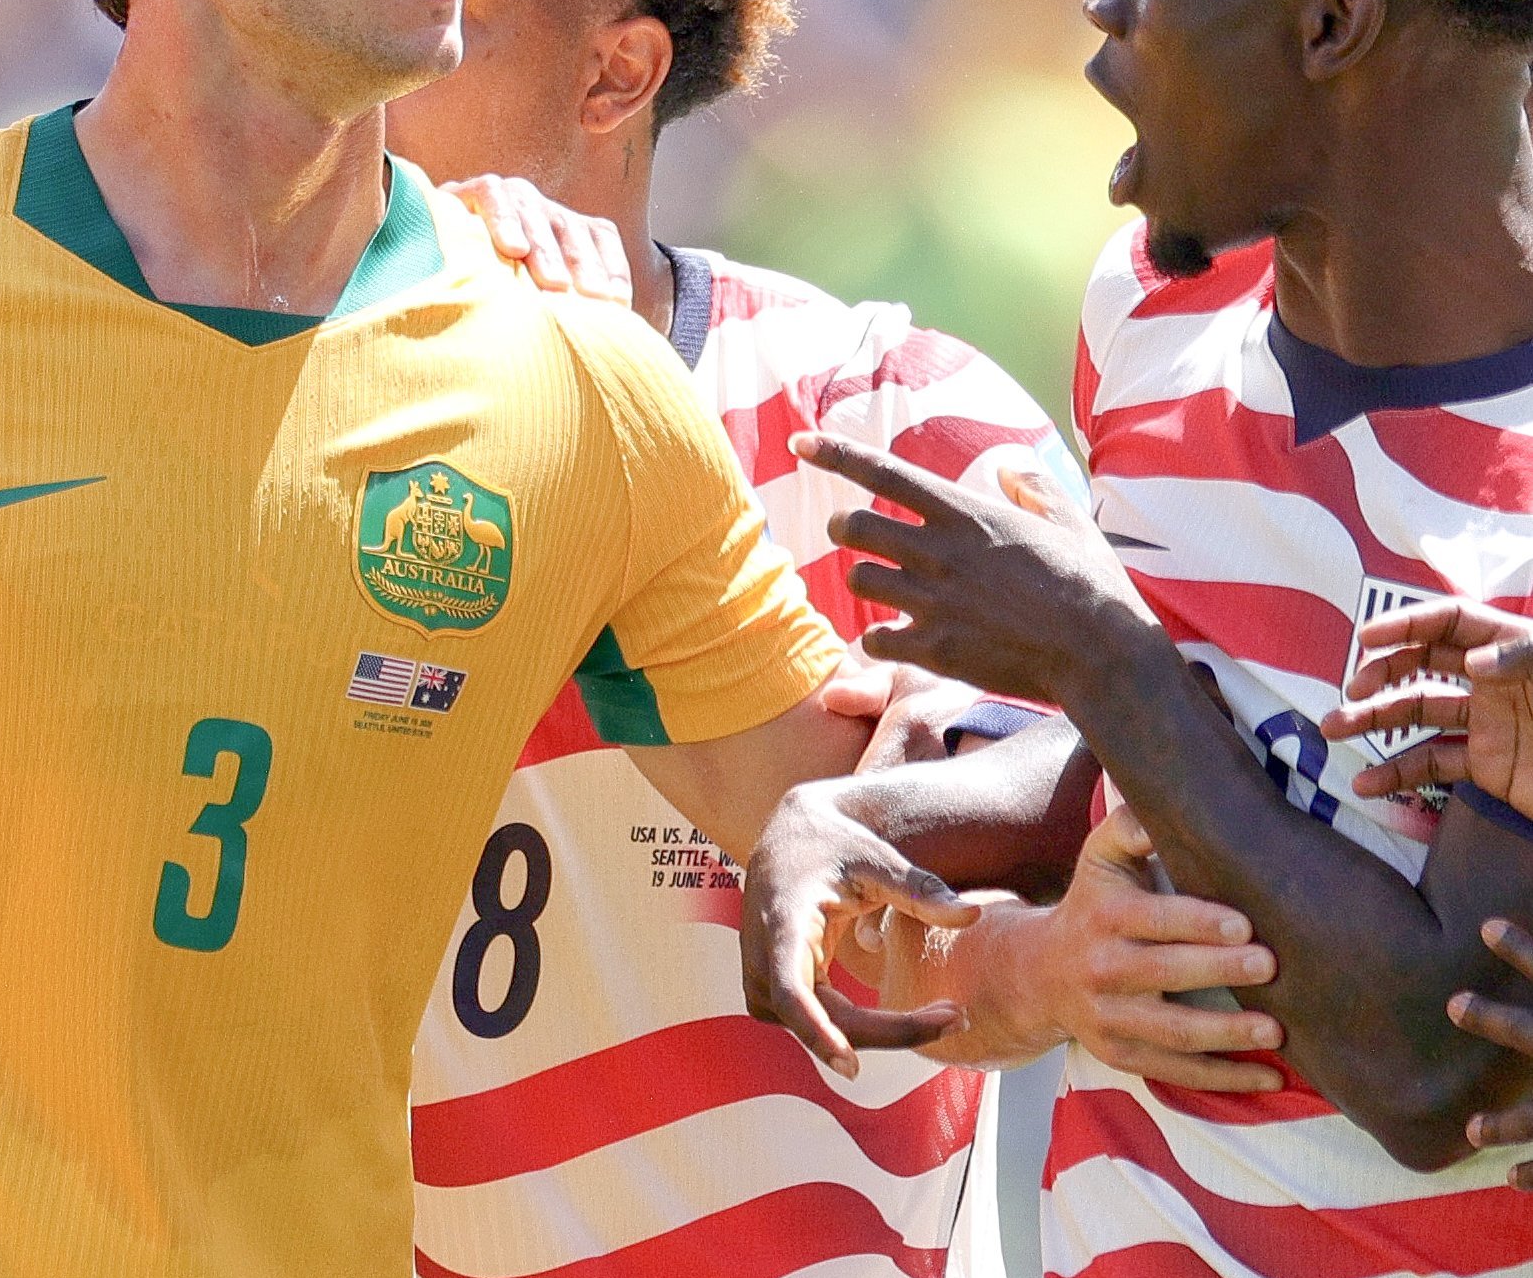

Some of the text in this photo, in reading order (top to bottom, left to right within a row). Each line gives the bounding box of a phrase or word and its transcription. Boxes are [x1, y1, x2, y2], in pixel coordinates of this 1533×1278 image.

[381, 559, 486, 595] AUSTRALIA
[153, 717, 273, 952] 3
[630, 826, 656, 843] USA
[662, 828, 683, 844] VS.
[651, 849, 712, 869] SEATTLE,
[652, 871, 740, 889] 19 JUNE 2026
[452, 822, 552, 1039] 8
